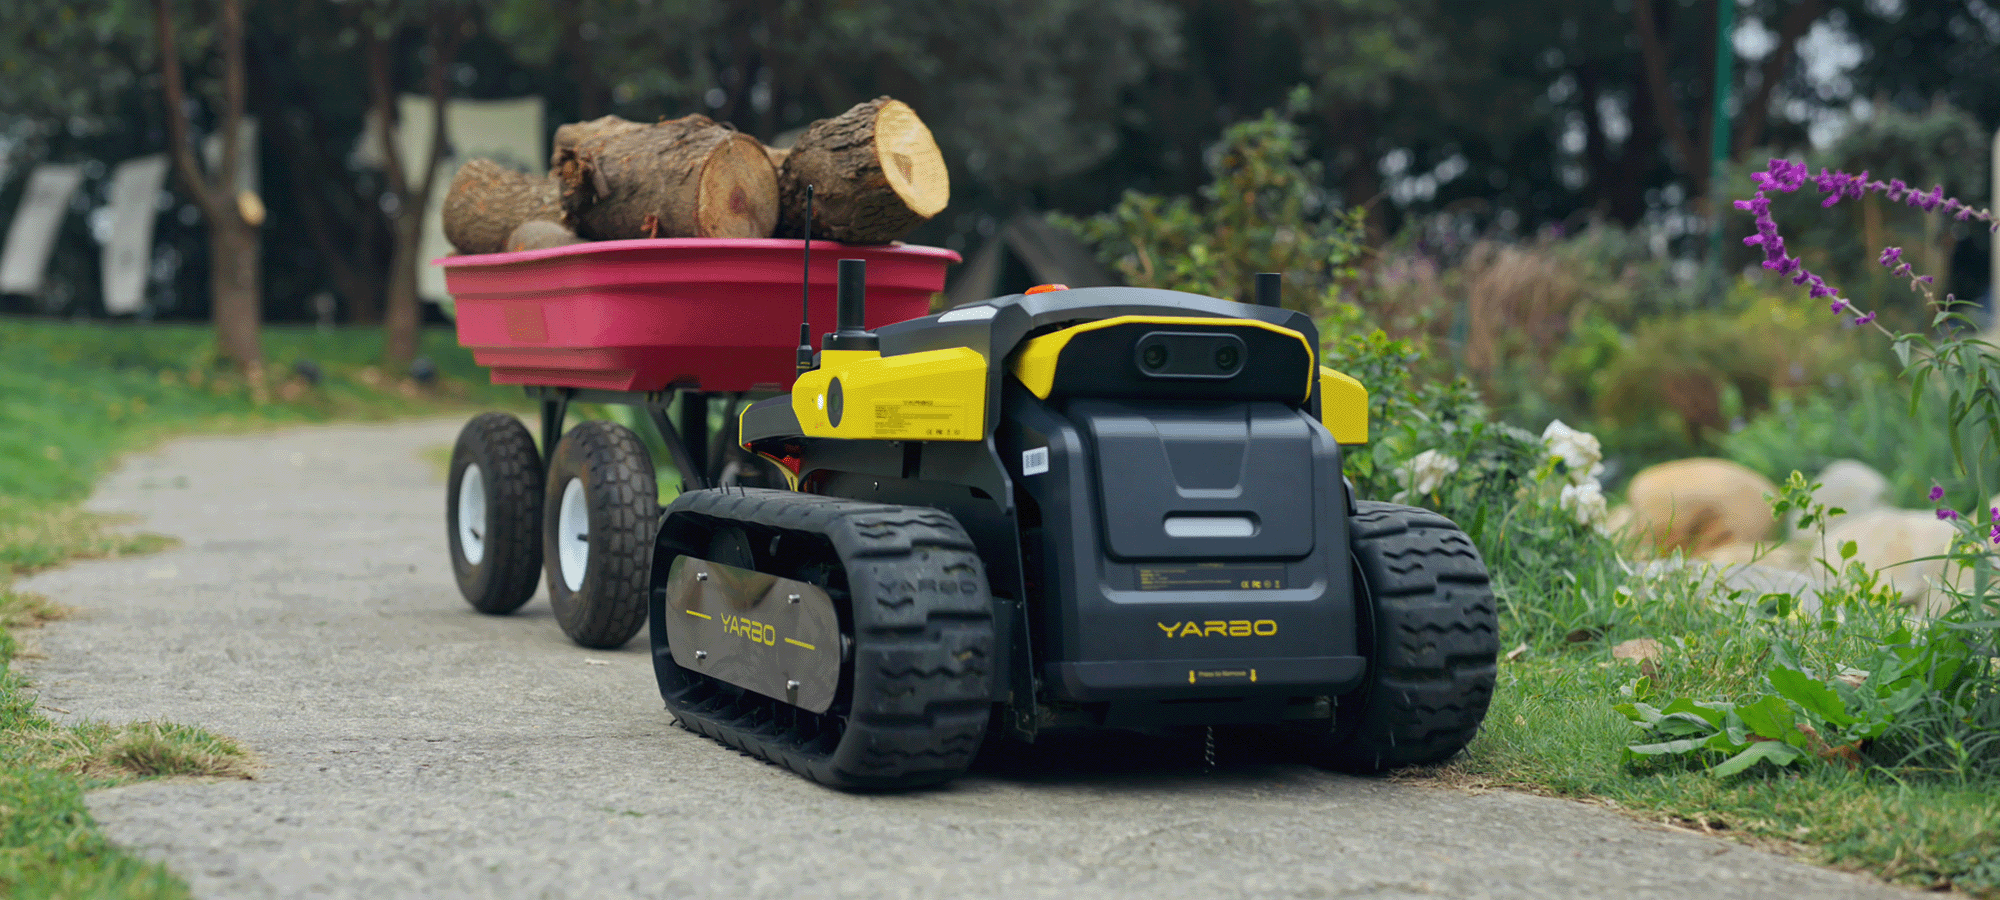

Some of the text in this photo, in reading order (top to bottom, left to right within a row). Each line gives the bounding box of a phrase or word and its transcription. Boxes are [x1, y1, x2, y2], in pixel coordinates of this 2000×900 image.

[878, 579, 978, 596] YARBO
[720, 612, 776, 647] YARBO
[1157, 619, 1277, 638] YARBO
